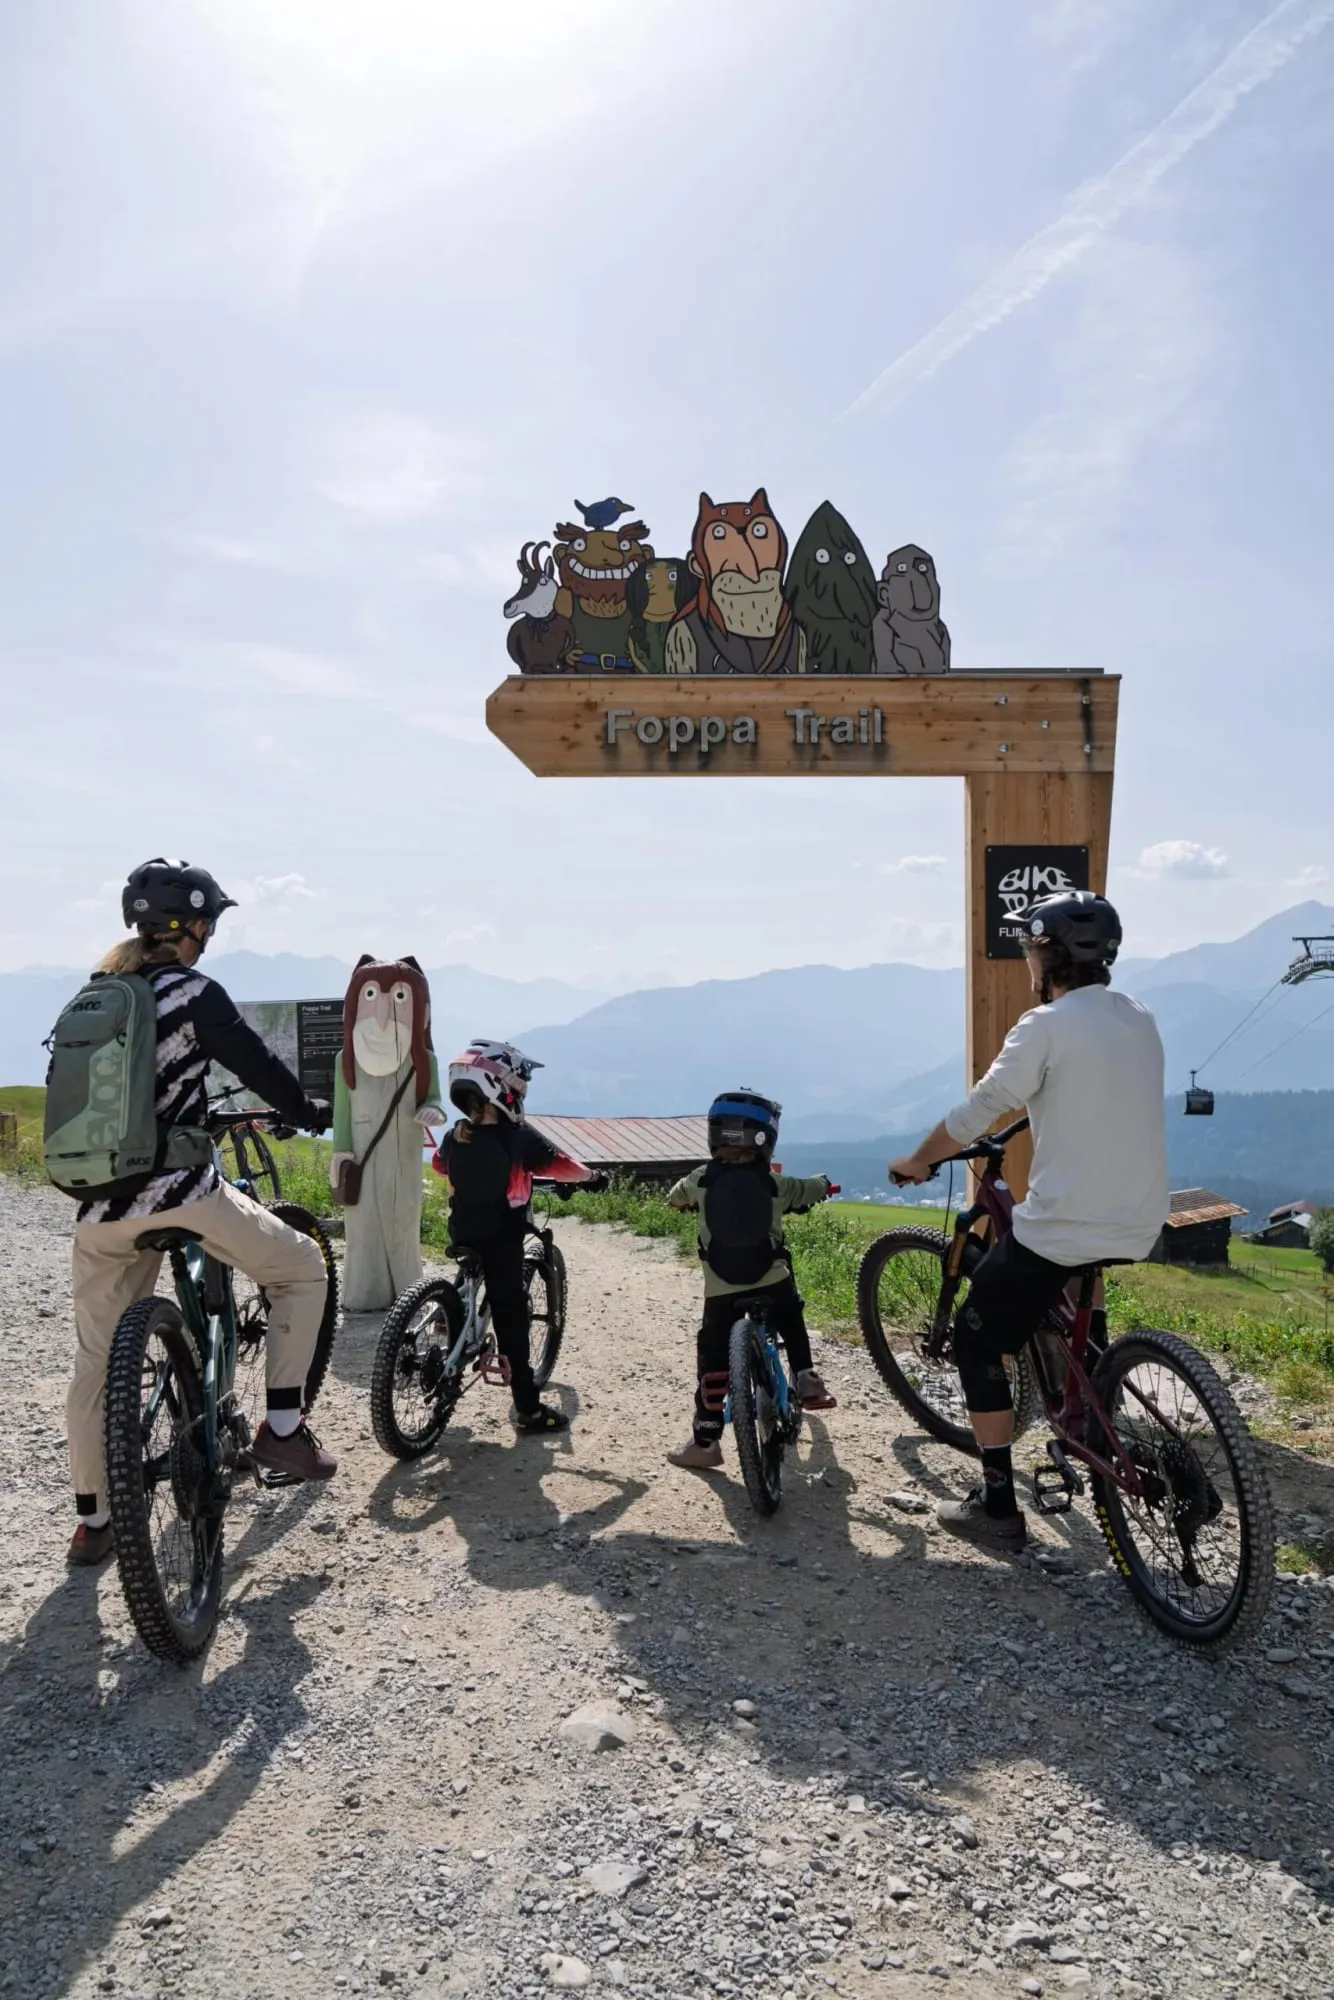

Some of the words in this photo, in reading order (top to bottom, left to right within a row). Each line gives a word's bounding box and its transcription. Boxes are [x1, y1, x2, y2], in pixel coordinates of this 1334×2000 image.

[605, 708, 757, 753] Foppa
[785, 708, 883, 744] Trail
[998, 865, 1077, 892] BIKE
[999, 927, 1029, 937] FLIM
